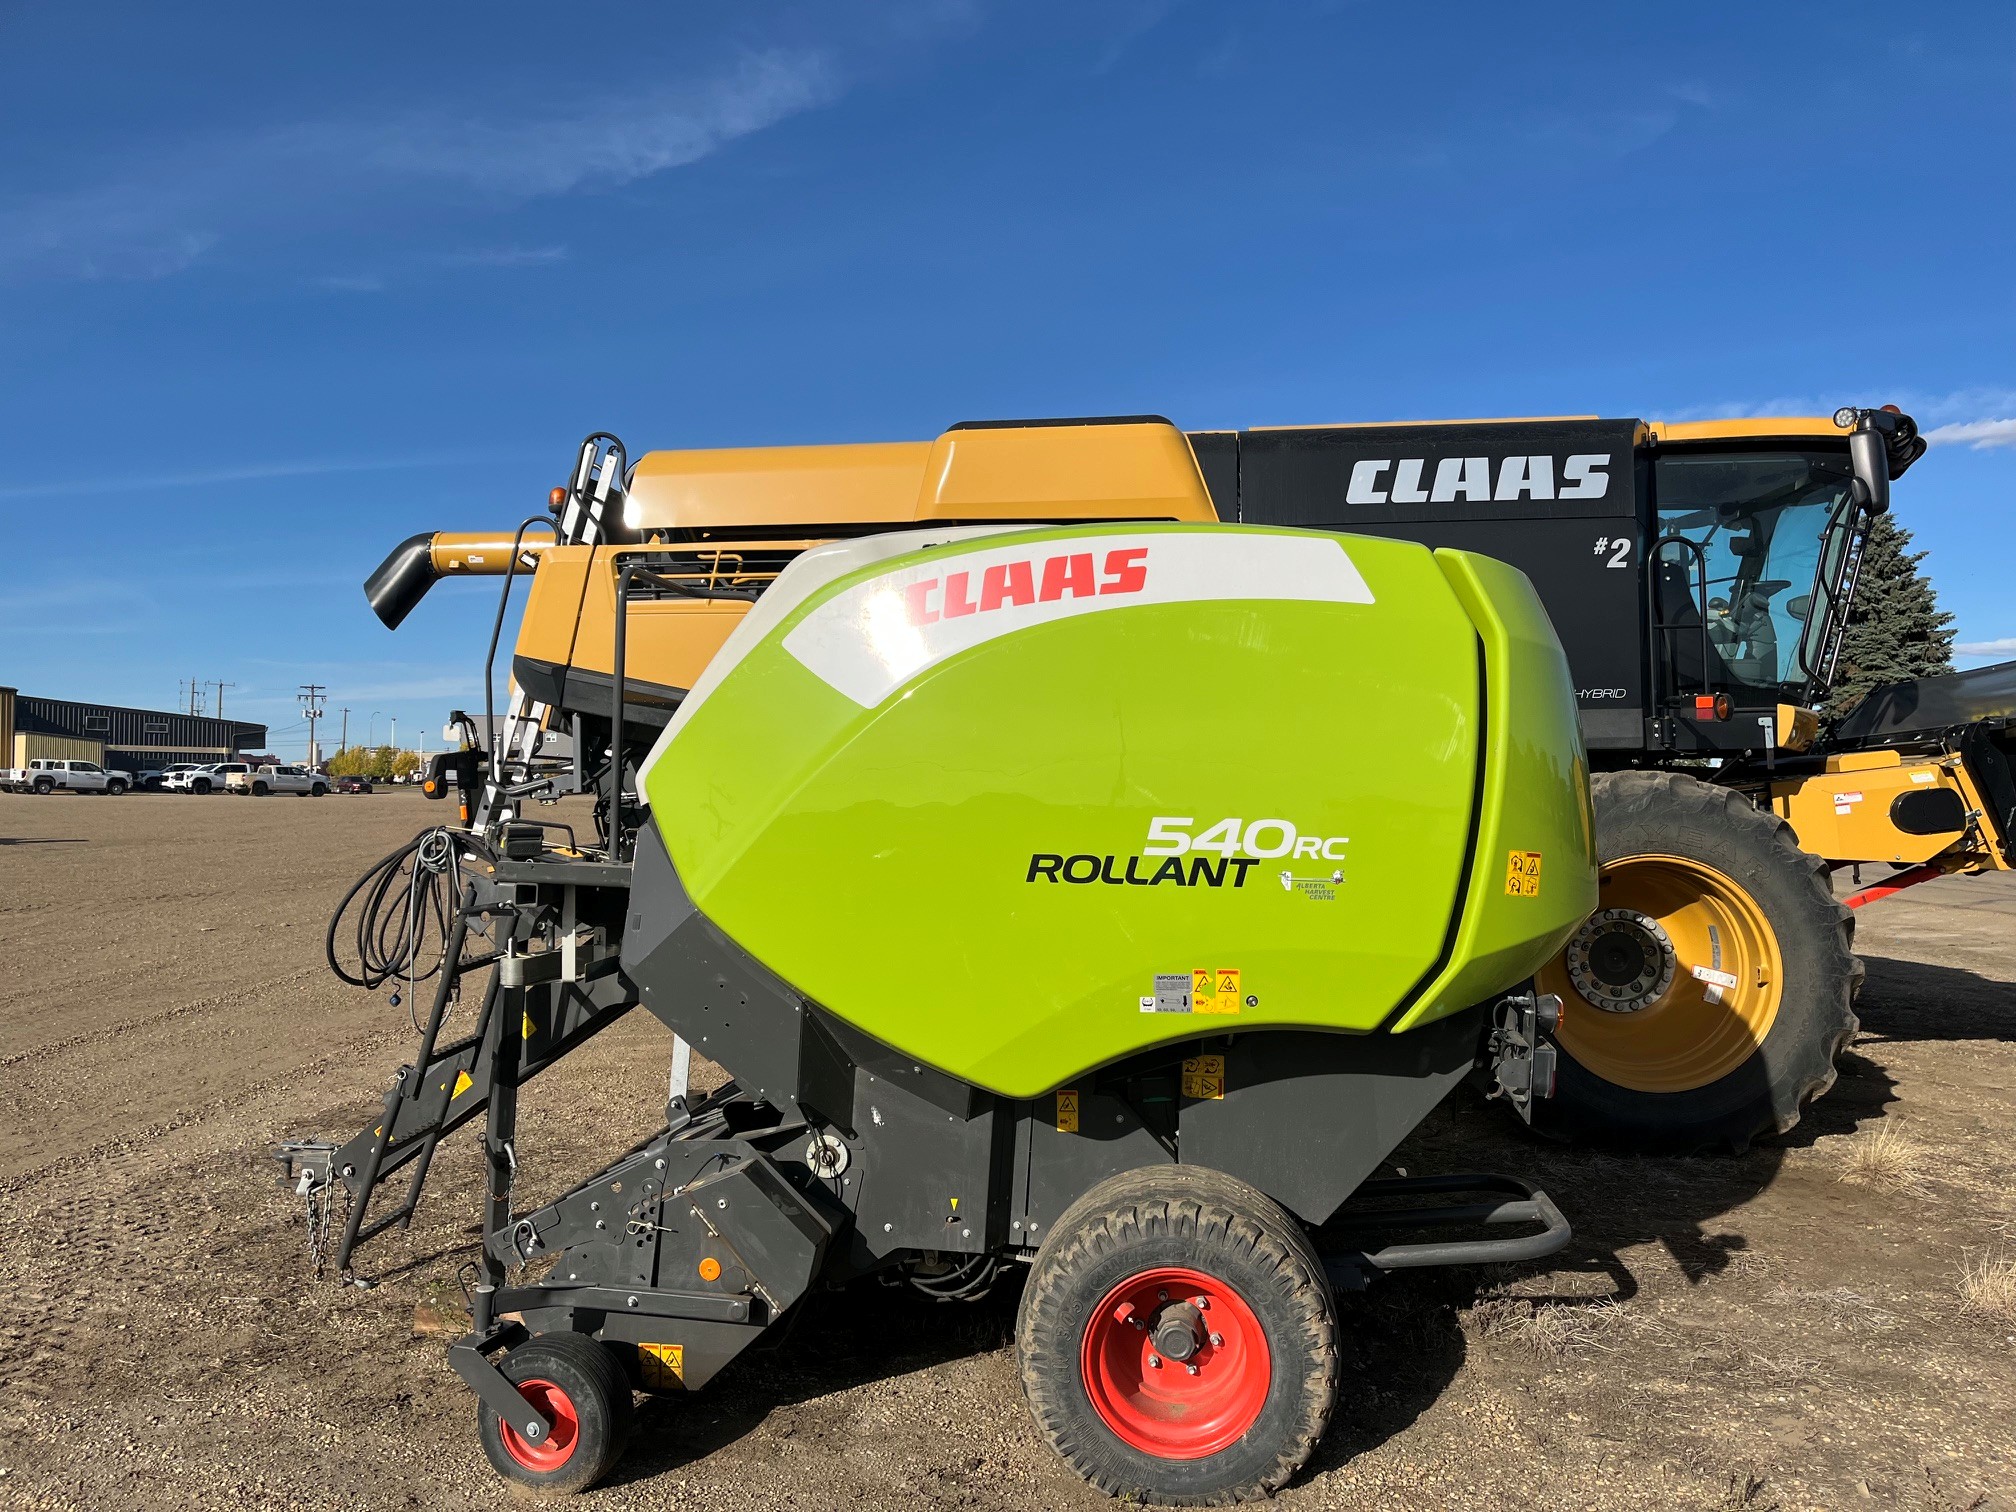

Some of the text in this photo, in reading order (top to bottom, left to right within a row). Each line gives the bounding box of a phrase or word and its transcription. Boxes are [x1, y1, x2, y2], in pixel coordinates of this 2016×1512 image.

[1346, 453, 1611, 504] CLAAS
[1593, 537, 1631, 568] #2
[905, 547, 1148, 627] CLAAS
[1574, 688, 1627, 699] HYBRID
[1025, 853, 1260, 888] ROLLANT
[1055, 1299, 1084, 1342] 305
